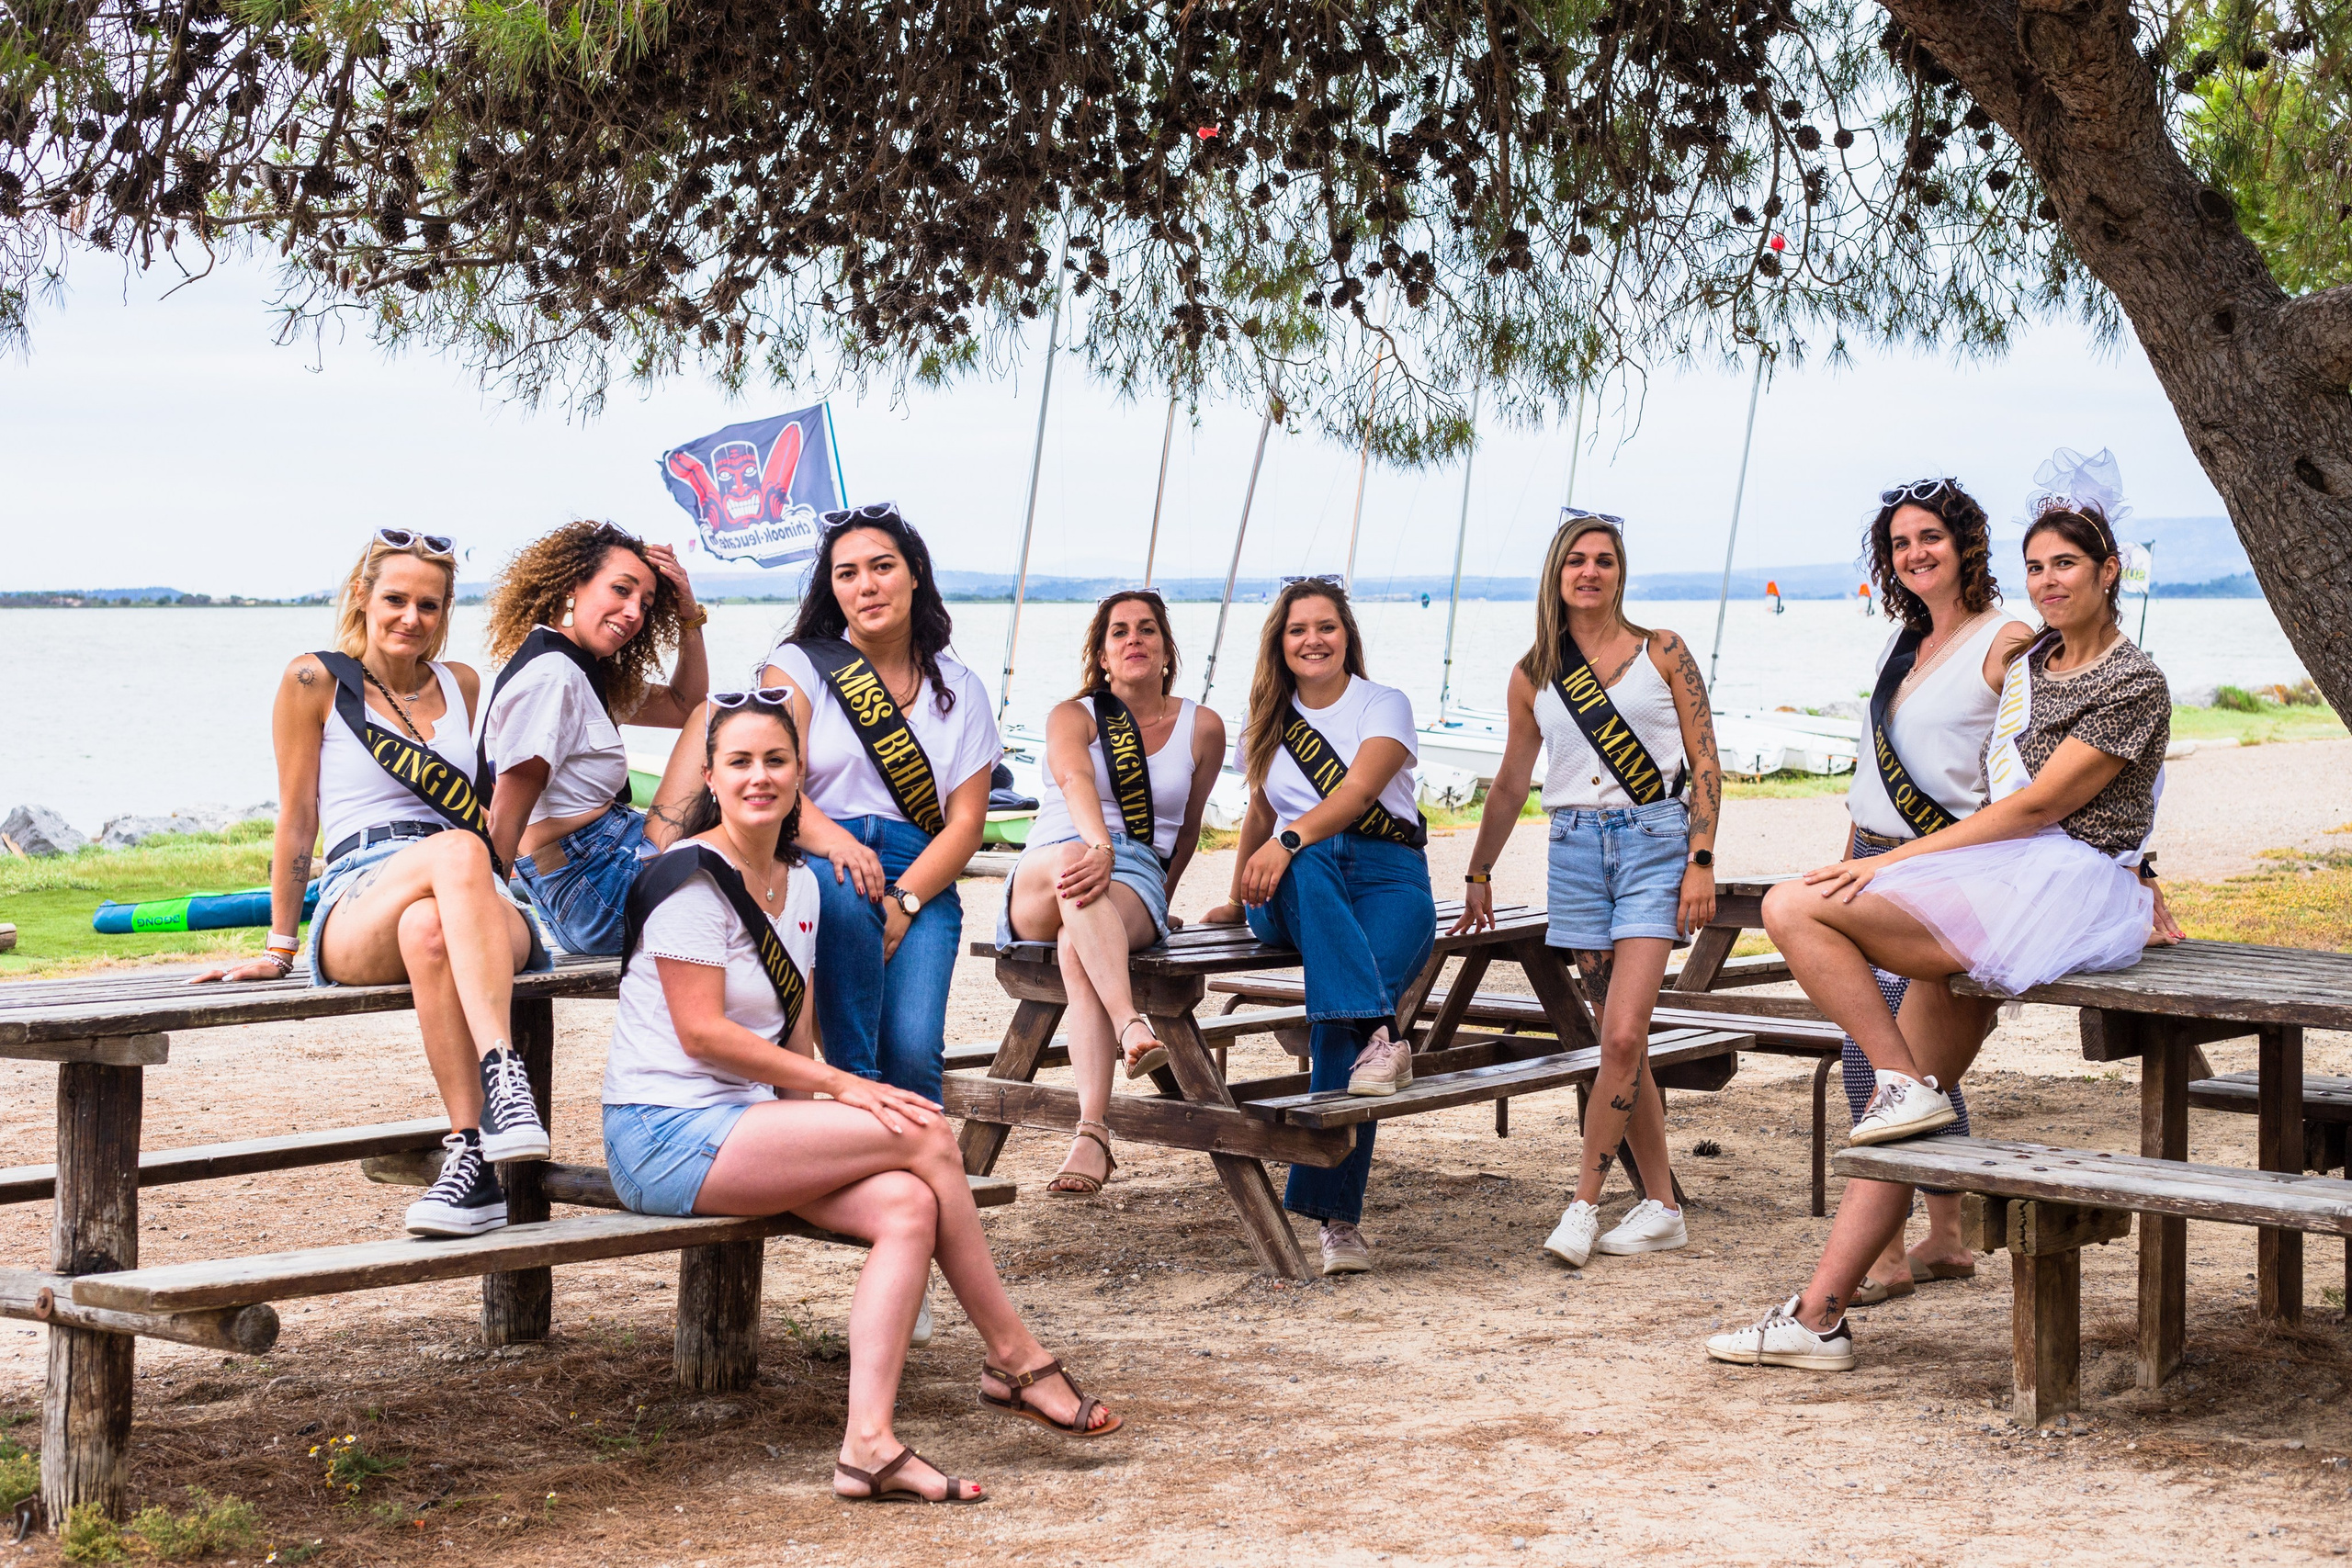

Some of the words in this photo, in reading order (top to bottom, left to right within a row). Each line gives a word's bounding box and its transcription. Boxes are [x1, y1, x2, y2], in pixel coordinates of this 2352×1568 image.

[831, 658, 893, 727] MISS
[1285, 718, 1322, 762] BAD
[1562, 664, 1608, 715] HOT
[1591, 714, 1663, 805] MAMA
